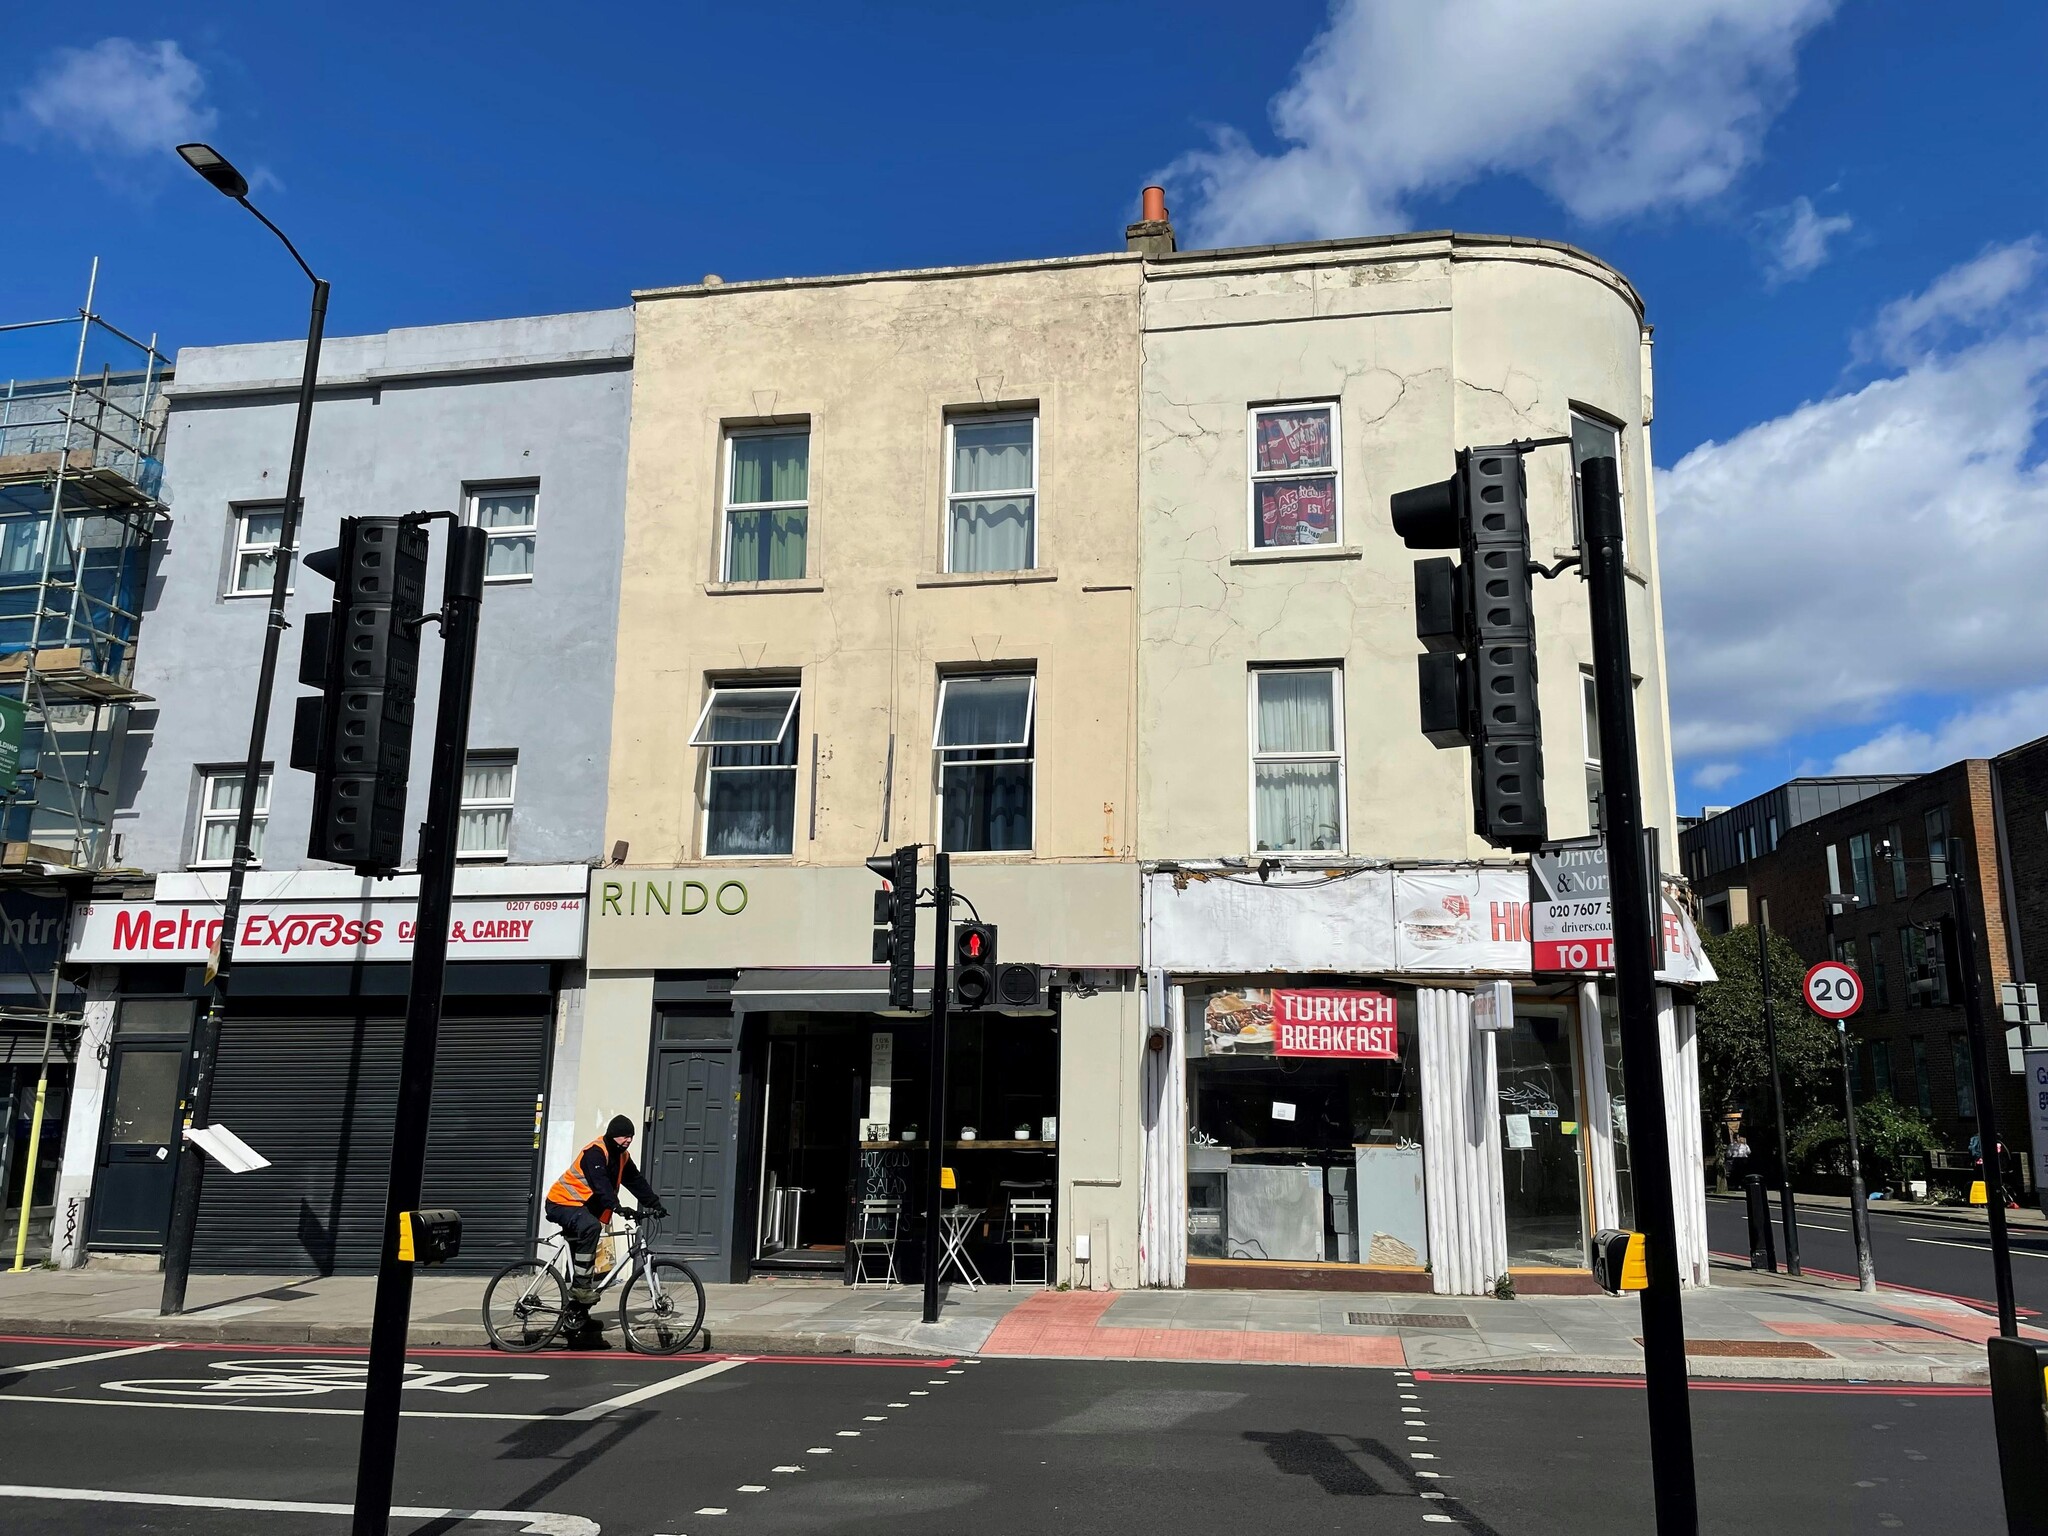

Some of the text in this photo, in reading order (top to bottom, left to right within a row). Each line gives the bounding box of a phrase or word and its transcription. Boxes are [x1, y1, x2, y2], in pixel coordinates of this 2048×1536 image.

[1557, 871, 1610, 894] &Nor
[506, 900, 580, 911] 0207 6099 444
[602, 880, 748, 916] RINDO
[78, 907, 94, 916] 138
[1550, 905, 1570, 918] 020
[1574, 902, 1602, 917] 7607
[452, 920, 467, 942] &
[472, 919, 534, 939] CARRY
[1557, 943, 1615, 968] TO LE
[1813, 978, 1855, 1001] 20
[1281, 996, 1394, 1023] TURKISH
[1281, 1024, 1394, 1052] BREAKFAST
[1193, 1131, 1219, 1145] حلال
[1395, 1135, 1422, 1150] حلال
[866, 1177, 907, 1194] SALAD
